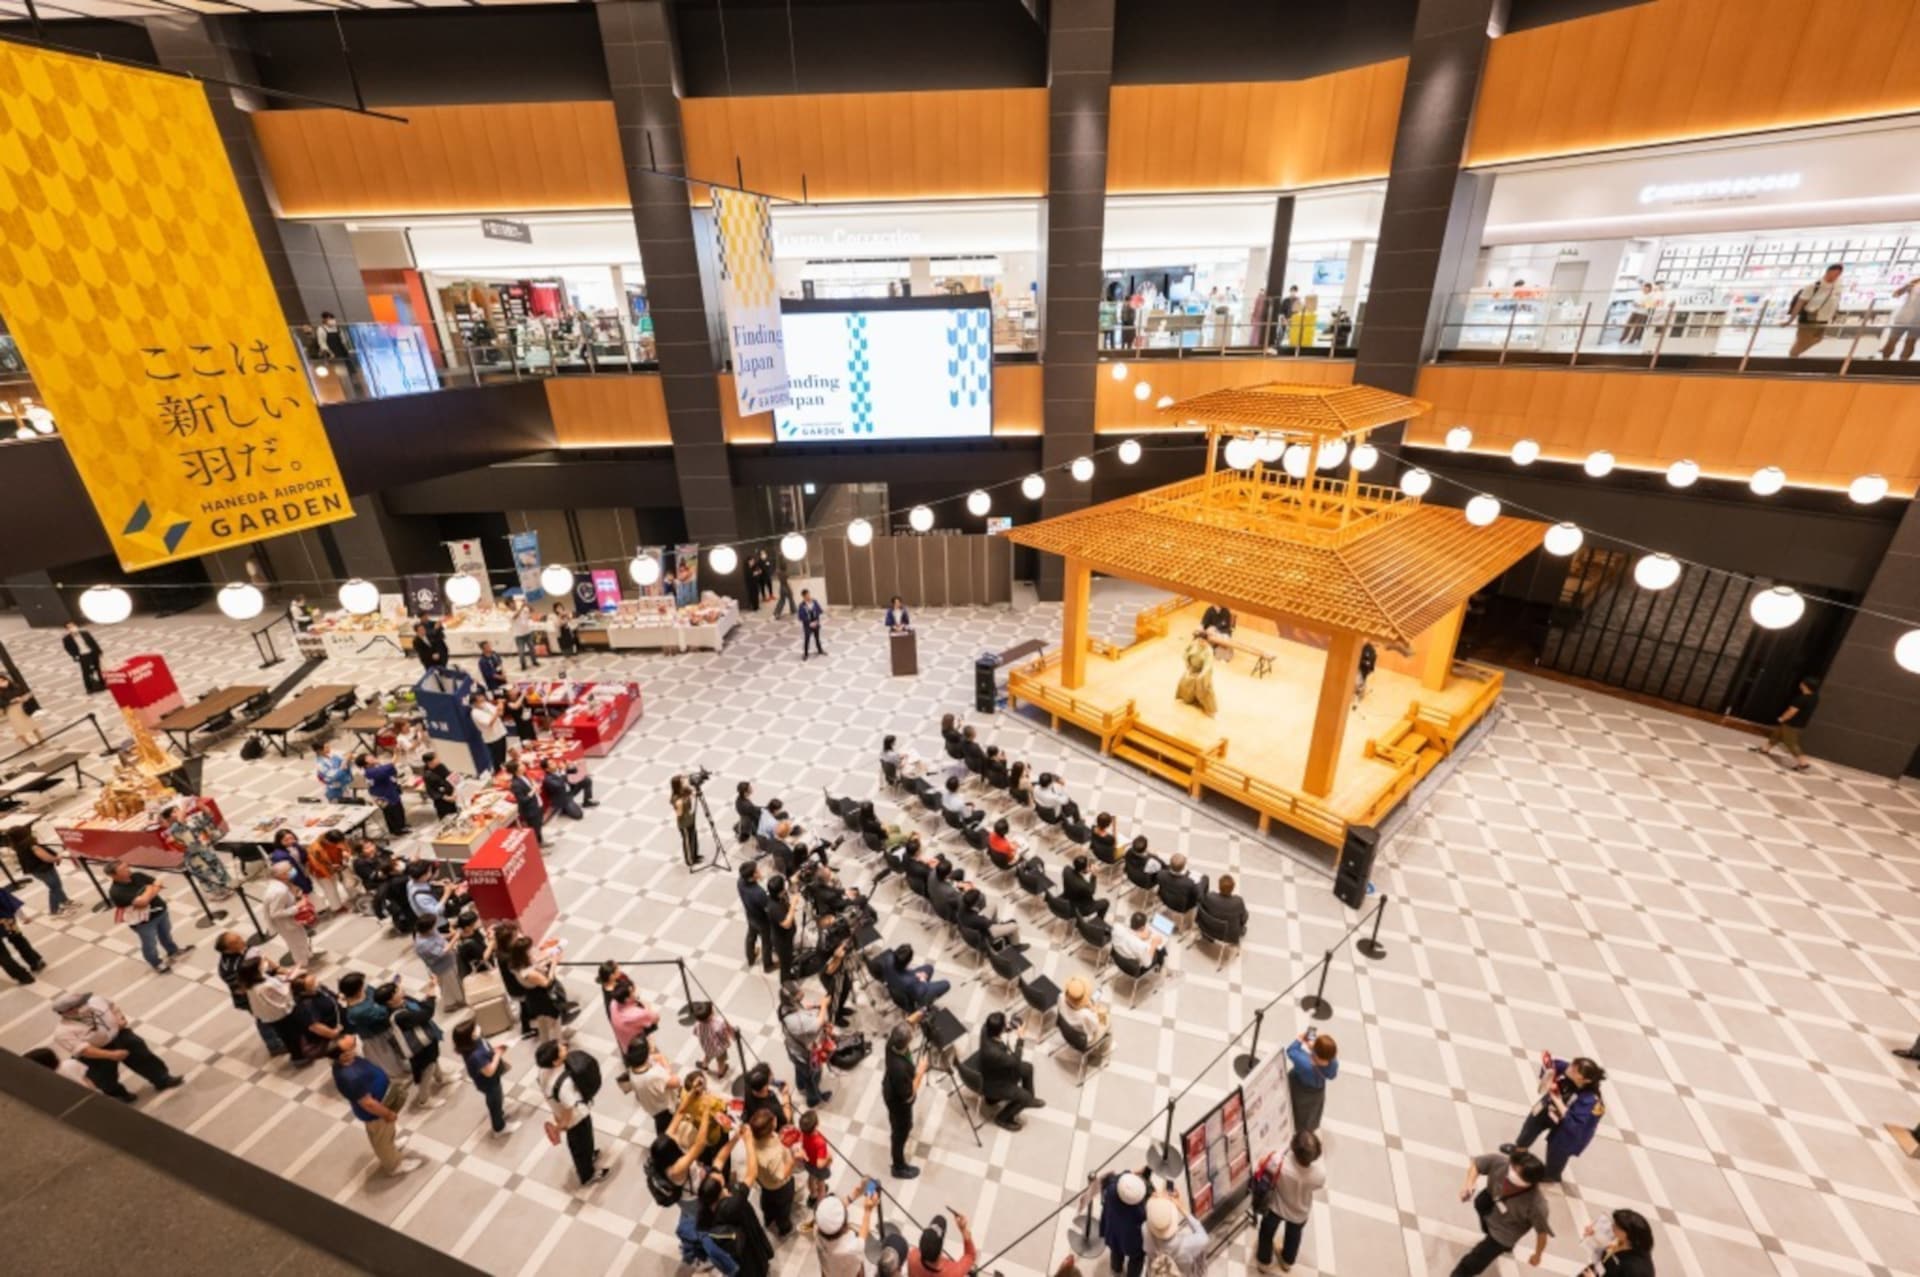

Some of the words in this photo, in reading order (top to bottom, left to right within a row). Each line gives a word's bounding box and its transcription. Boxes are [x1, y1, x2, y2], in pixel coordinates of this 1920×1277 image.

[732, 324, 783, 349] Finding
[141, 339, 297, 380] ここは、
[738, 352, 774, 378] Japan
[787, 374, 840, 392] inding
[157, 394, 301, 437] 新しい
[790, 396, 824, 411] pan
[179, 438, 303, 487] 羽だ。
[201, 491, 268, 513] HANEDA
[274, 478, 332, 498] AIRPORT
[211, 493, 342, 537] GARDEN
